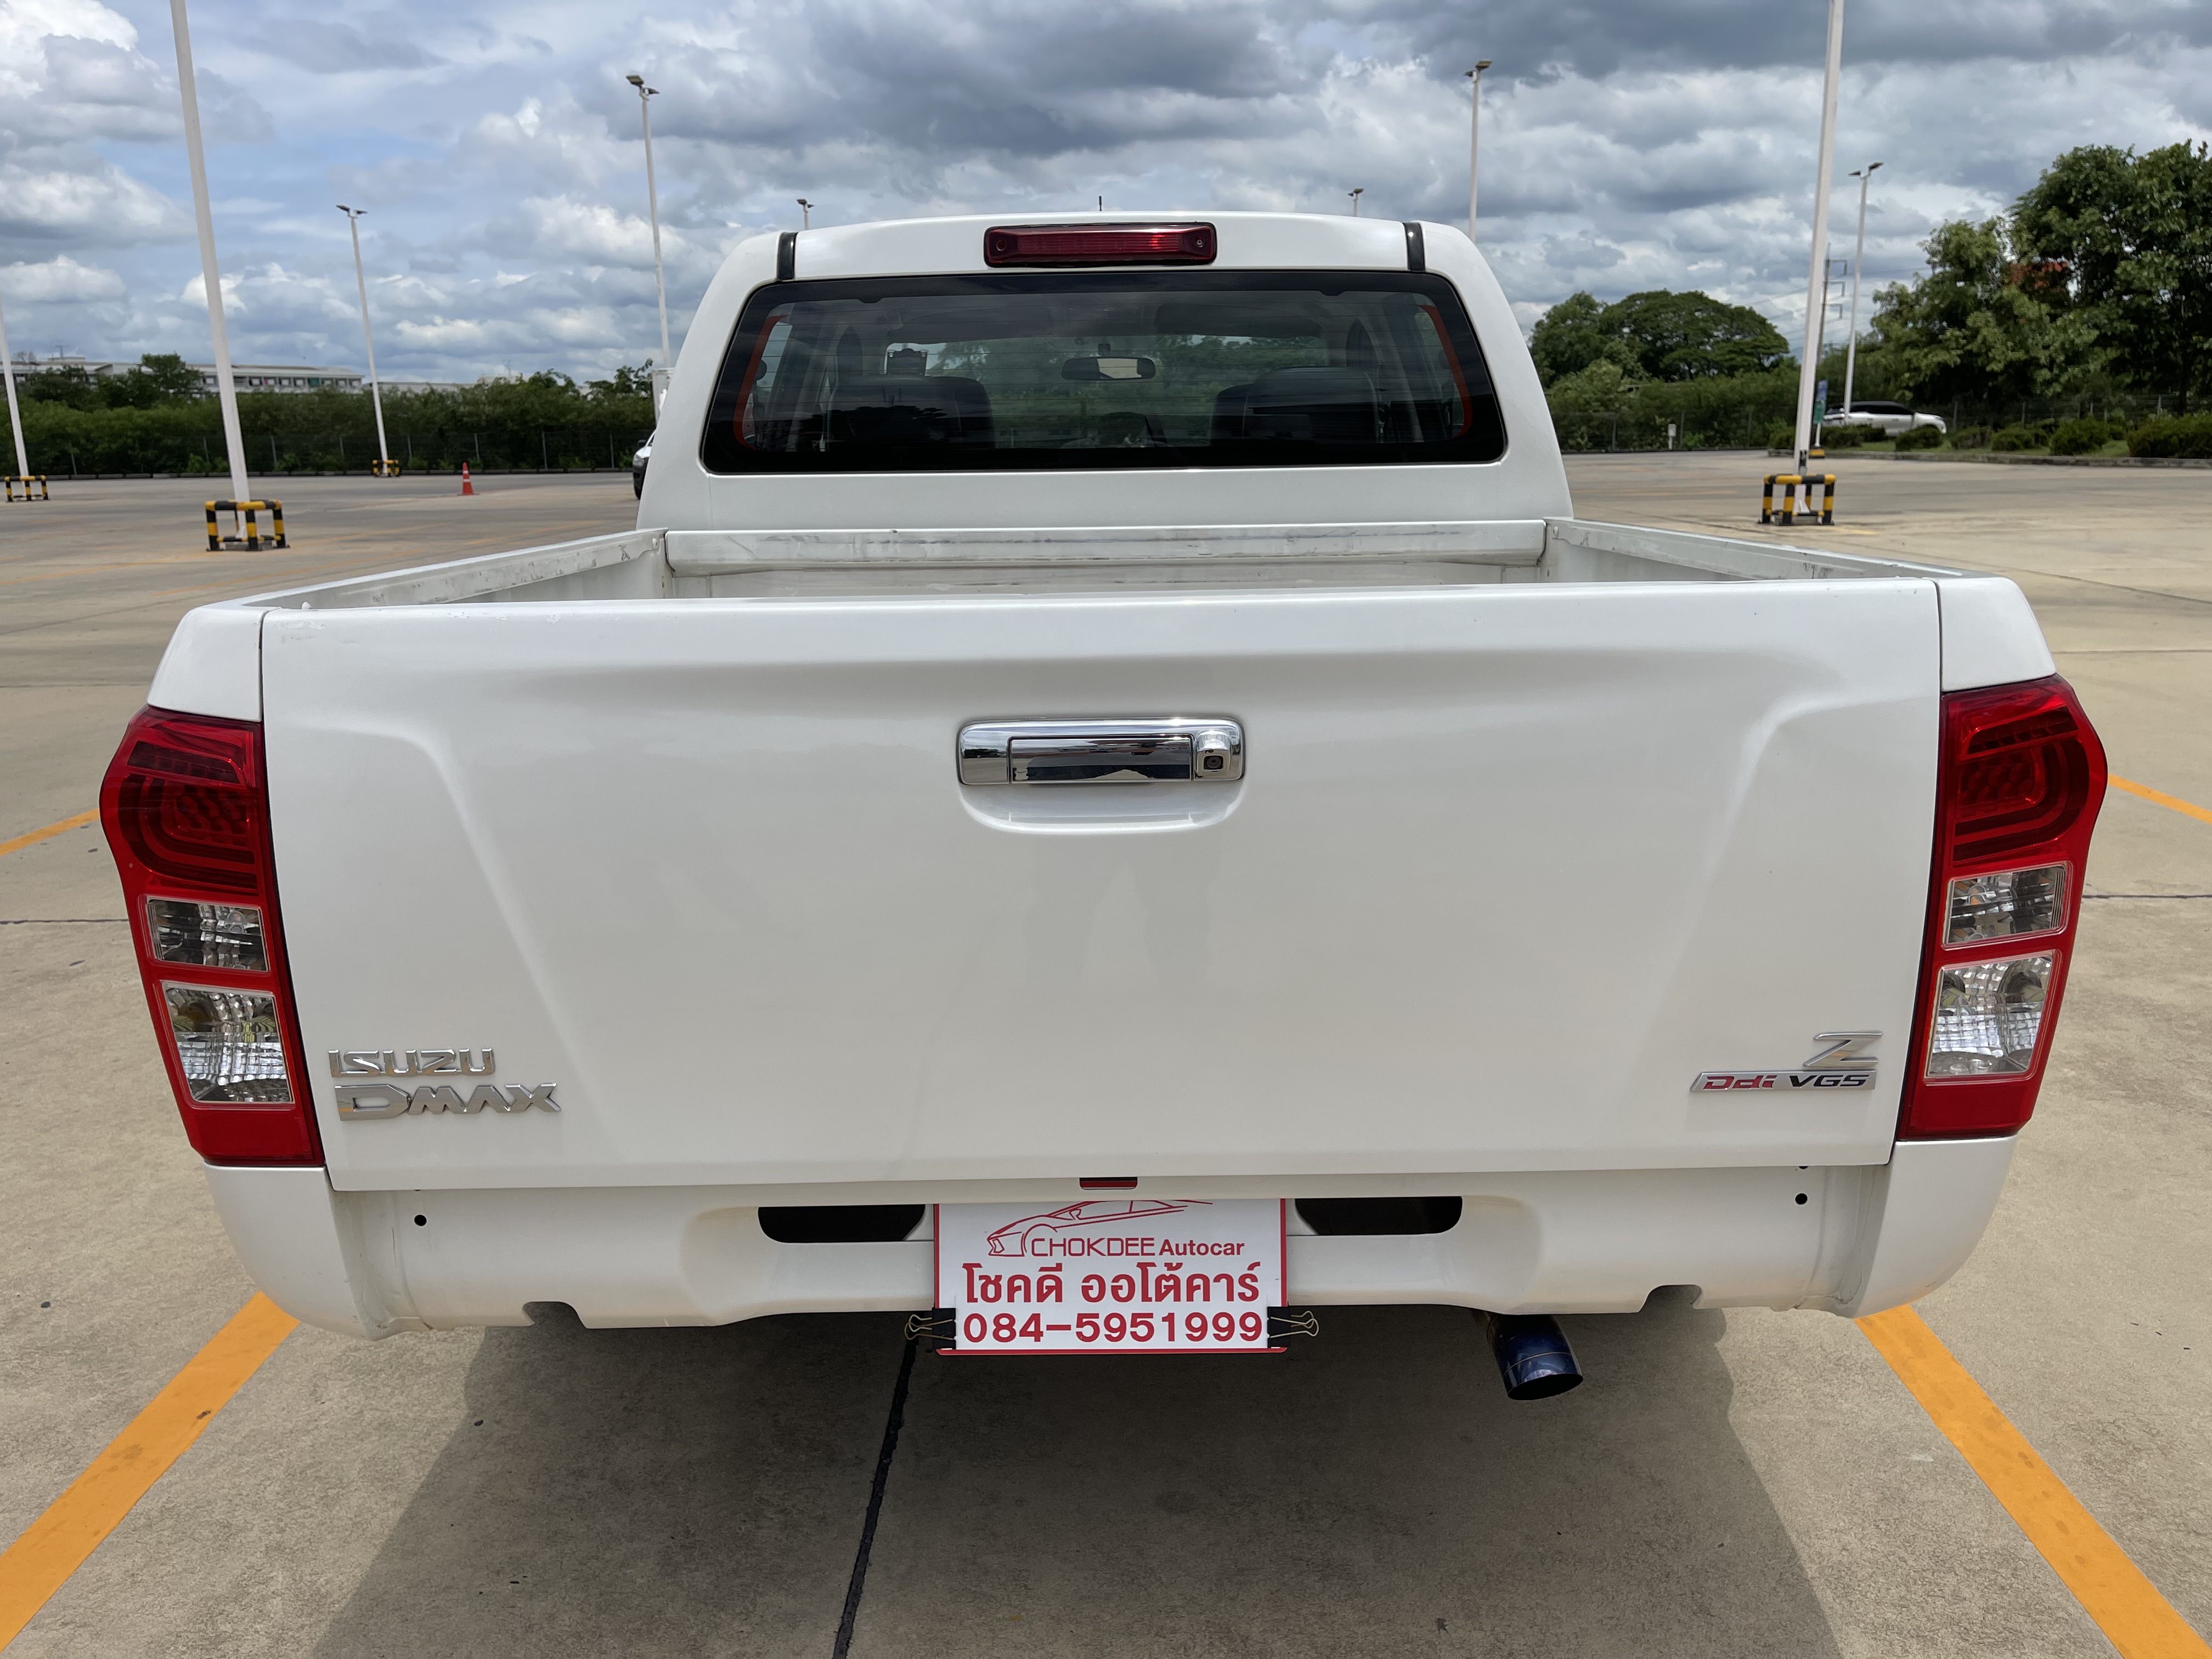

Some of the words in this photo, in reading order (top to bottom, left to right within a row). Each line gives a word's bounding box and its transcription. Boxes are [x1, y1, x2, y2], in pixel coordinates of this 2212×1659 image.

[328, 1048, 495, 1077] ISUZU
[1803, 1030, 1883, 1068] Z
[1703, 1075, 1778, 1090] Ddi
[1789, 1074, 1870, 1088] VGS
[1031, 1237, 1155, 1257] CHOKDEE
[1158, 1239, 1245, 1256] Autocar
[962, 1262, 1063, 1304] โชคดี
[1080, 1261, 1261, 1303] ออโต้คาร์
[963, 1311, 1263, 1343] 084-5951999
